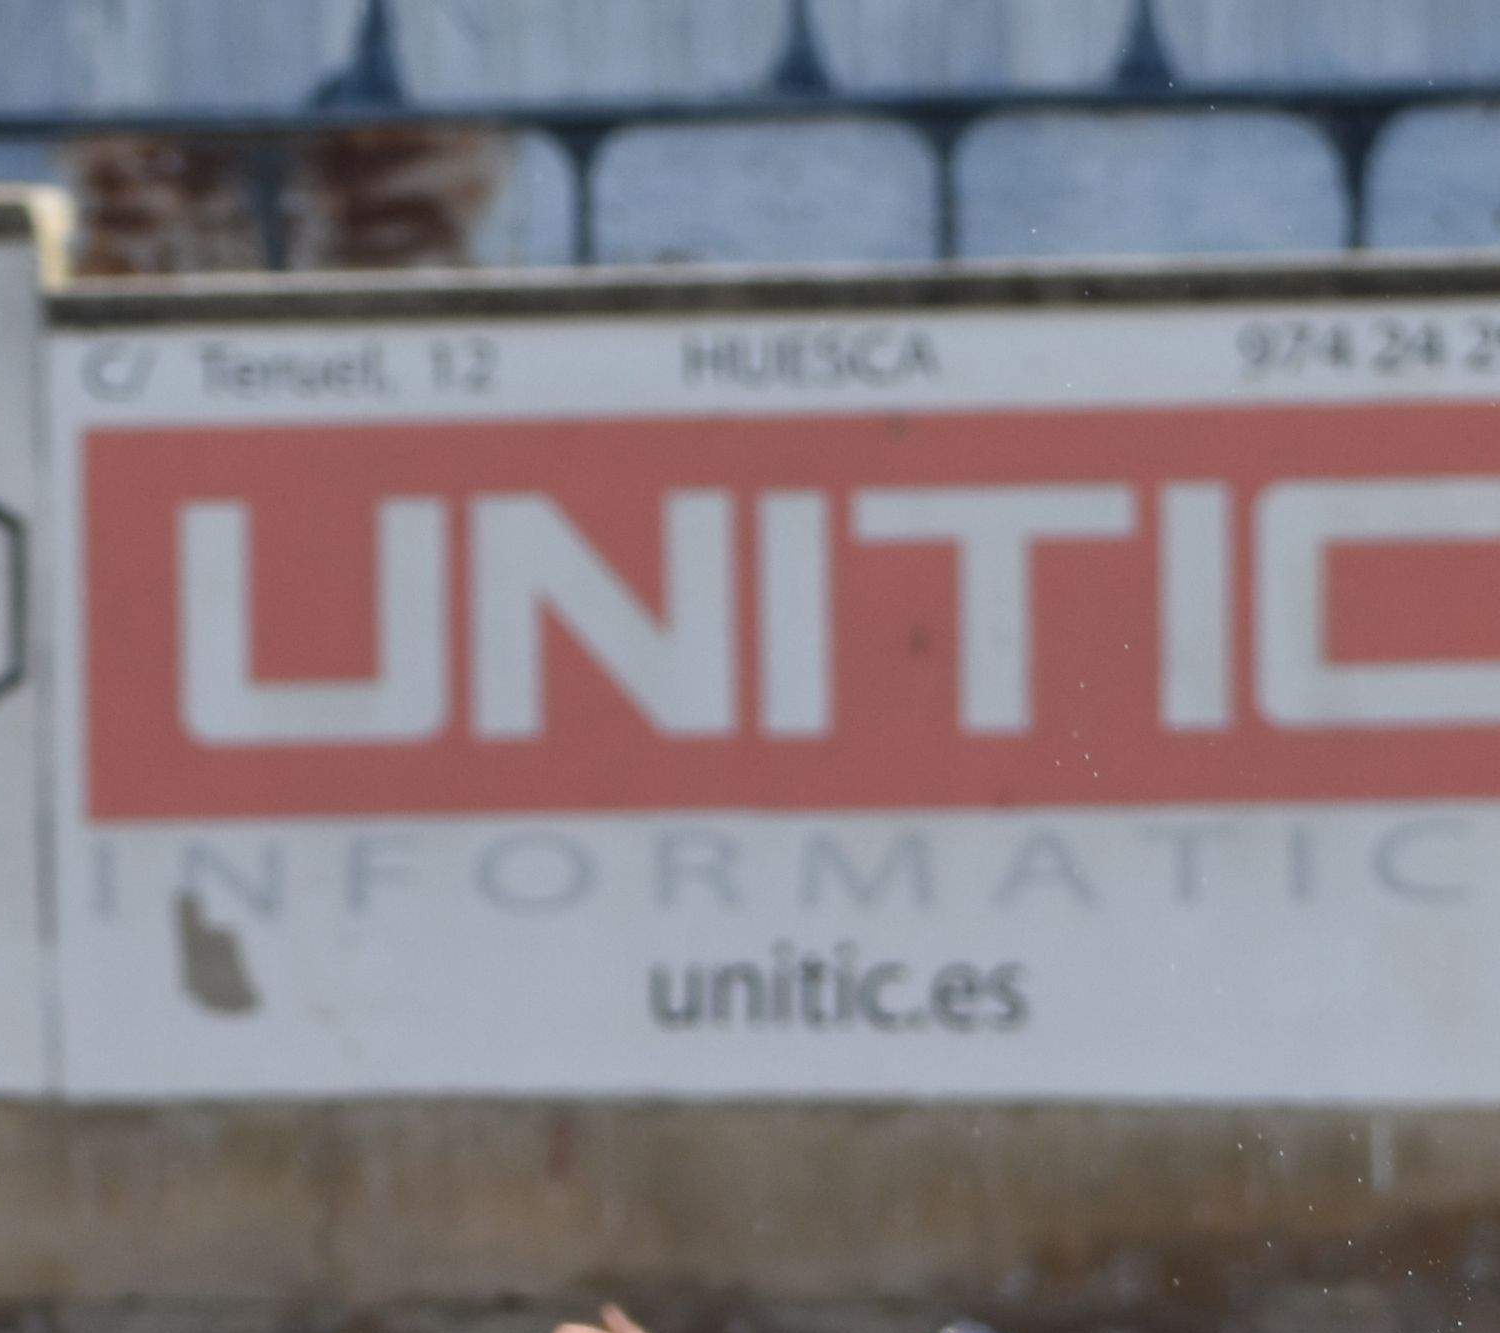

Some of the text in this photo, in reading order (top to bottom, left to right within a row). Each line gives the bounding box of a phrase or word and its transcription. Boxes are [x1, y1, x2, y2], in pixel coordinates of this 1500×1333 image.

[423, 335, 497, 394] 12
[678, 328, 942, 390] HUESCA
[1234, 318, 1358, 382] 974
[1366, 314, 1448, 378] 24
[646, 942, 1032, 1036] unitic.es
